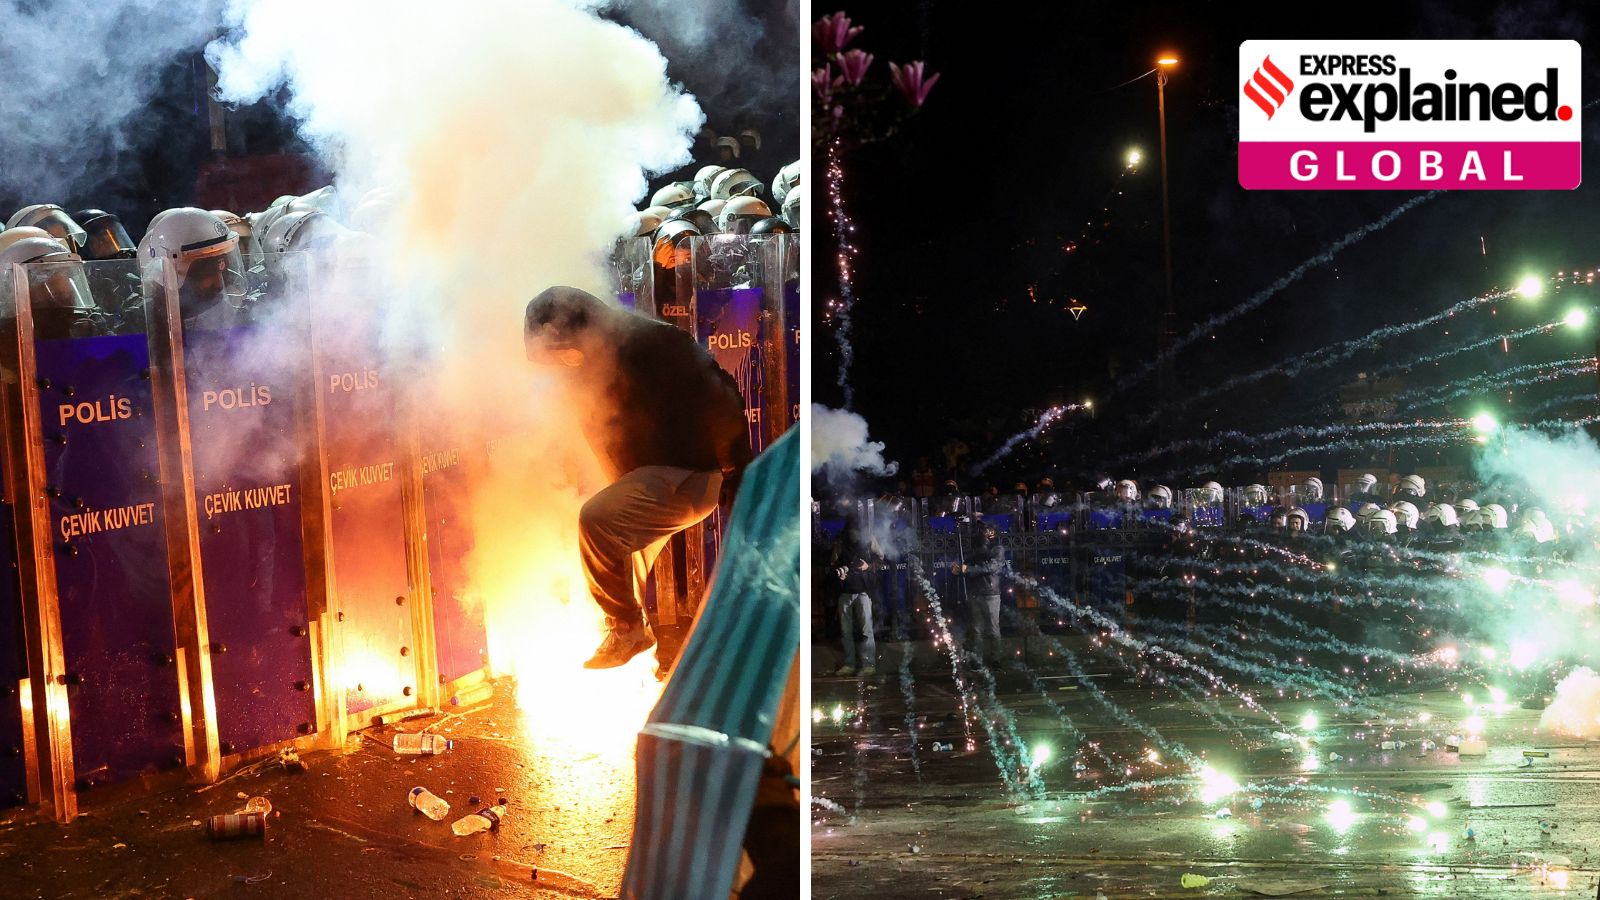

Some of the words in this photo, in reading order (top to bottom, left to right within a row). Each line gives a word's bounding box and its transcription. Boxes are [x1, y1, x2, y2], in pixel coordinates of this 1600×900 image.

[662, 303, 689, 316] ÖZEL
[708, 330, 751, 350] POLİS
[330, 367, 378, 392] POLİS
[59, 395, 132, 425] POLİS
[203, 383, 272, 411] POLİS
[330, 465, 358, 495] ÇEVİK
[360, 462, 394, 484] KUVVET
[204, 489, 242, 519] ÇEVİK
[244, 484, 291, 508] KUVVET
[60, 509, 102, 542] ÇEVİK
[104, 503, 154, 529] KUVVET
